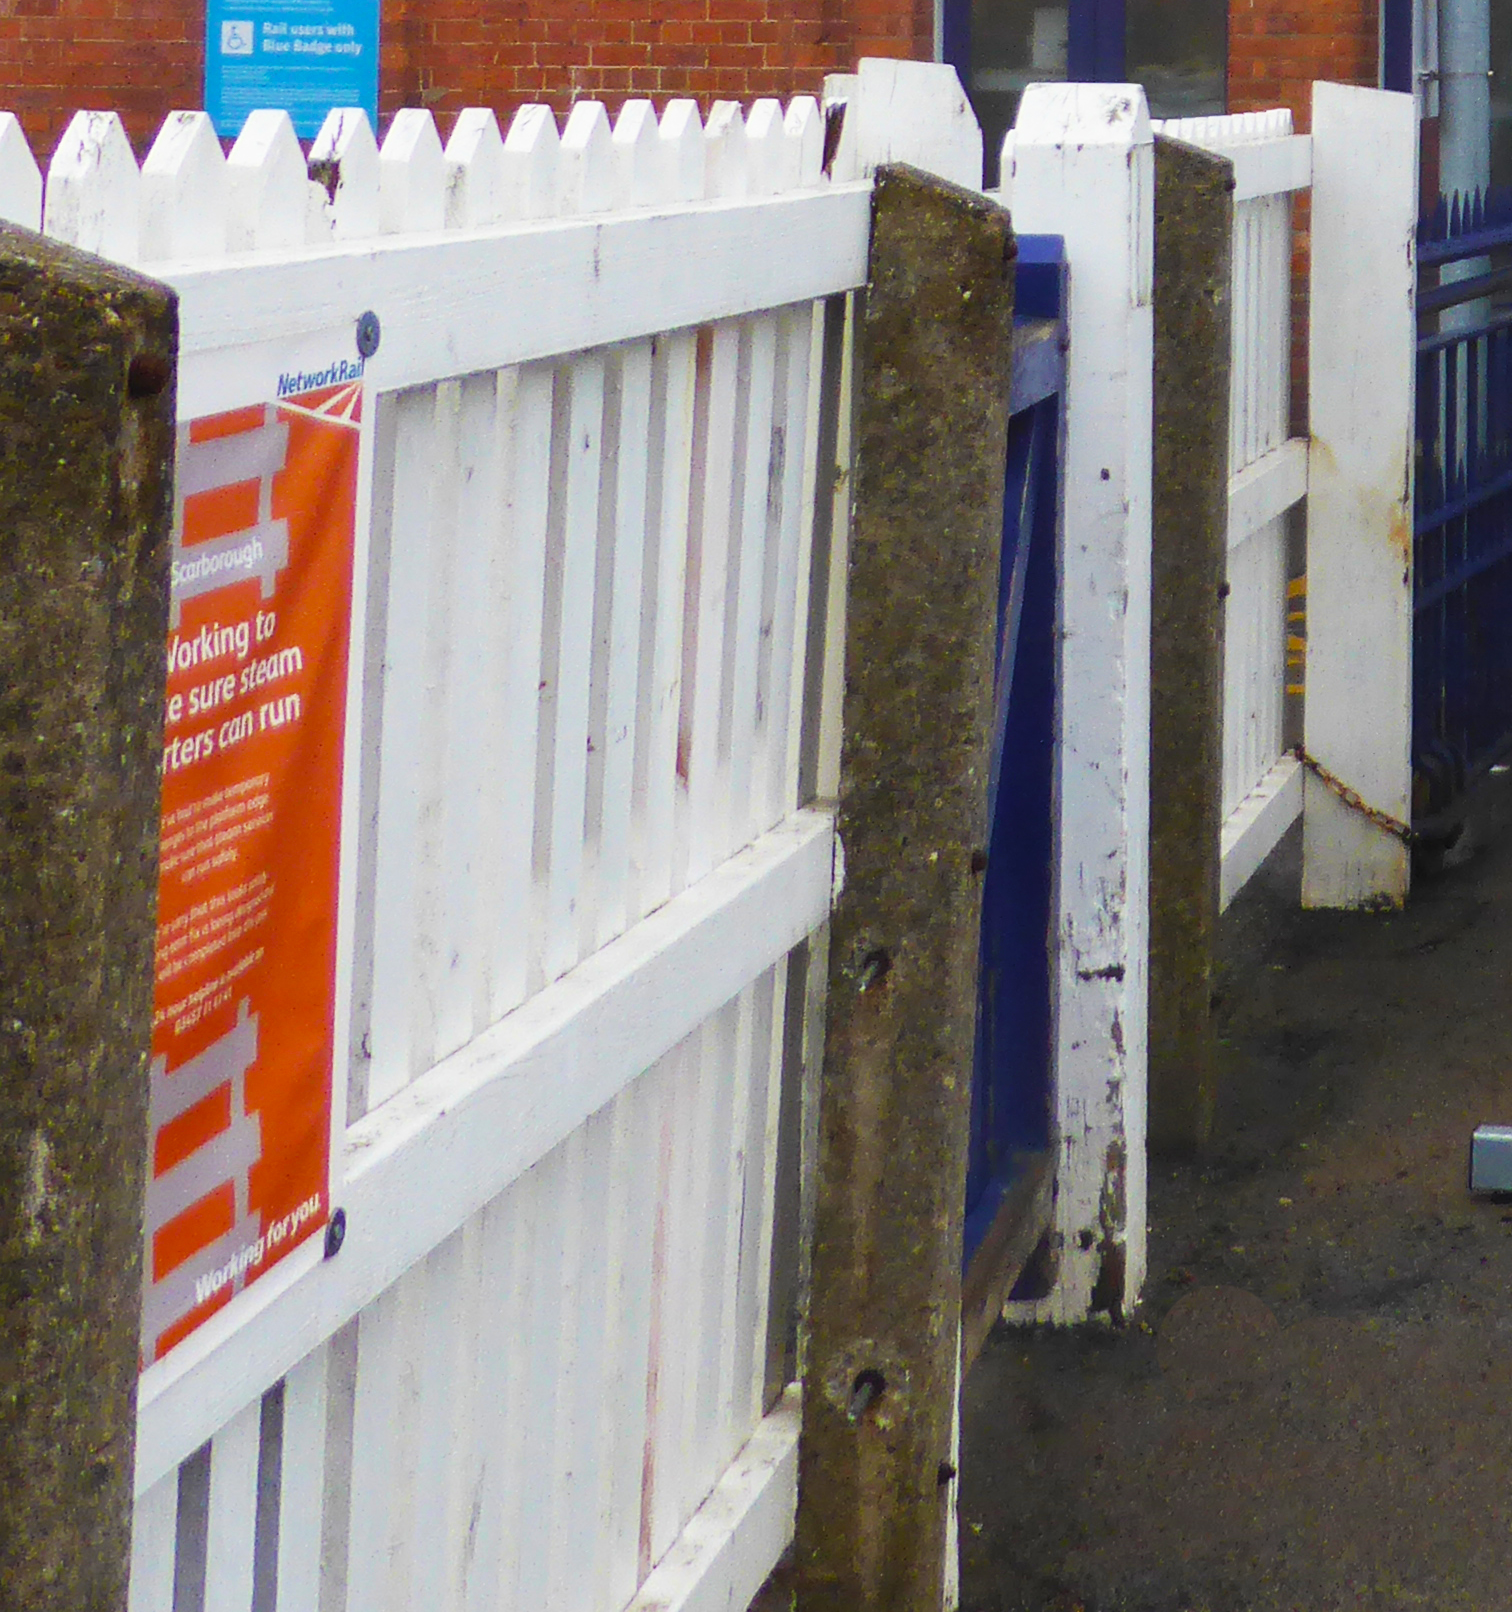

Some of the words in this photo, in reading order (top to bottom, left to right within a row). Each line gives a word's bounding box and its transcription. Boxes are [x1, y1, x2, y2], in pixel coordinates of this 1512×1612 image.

[262, 21, 287, 35] Rail
[290, 24, 323, 35] users
[326, 21, 355, 35] with
[262, 39, 290, 52] Blue
[294, 39, 332, 55] Badge
[335, 41, 363, 55] only
[277, 356, 364, 397] NetworkRail
[172, 537, 263, 584] Scarborough
[256, 610, 276, 642] to
[189, 673, 236, 715] sure
[240, 645, 303, 694] steam
[163, 728, 214, 774] rters
[218, 710, 254, 750] can
[260, 693, 302, 731] run
[194, 1238, 265, 1303] Working
[267, 1219, 290, 1249] for
